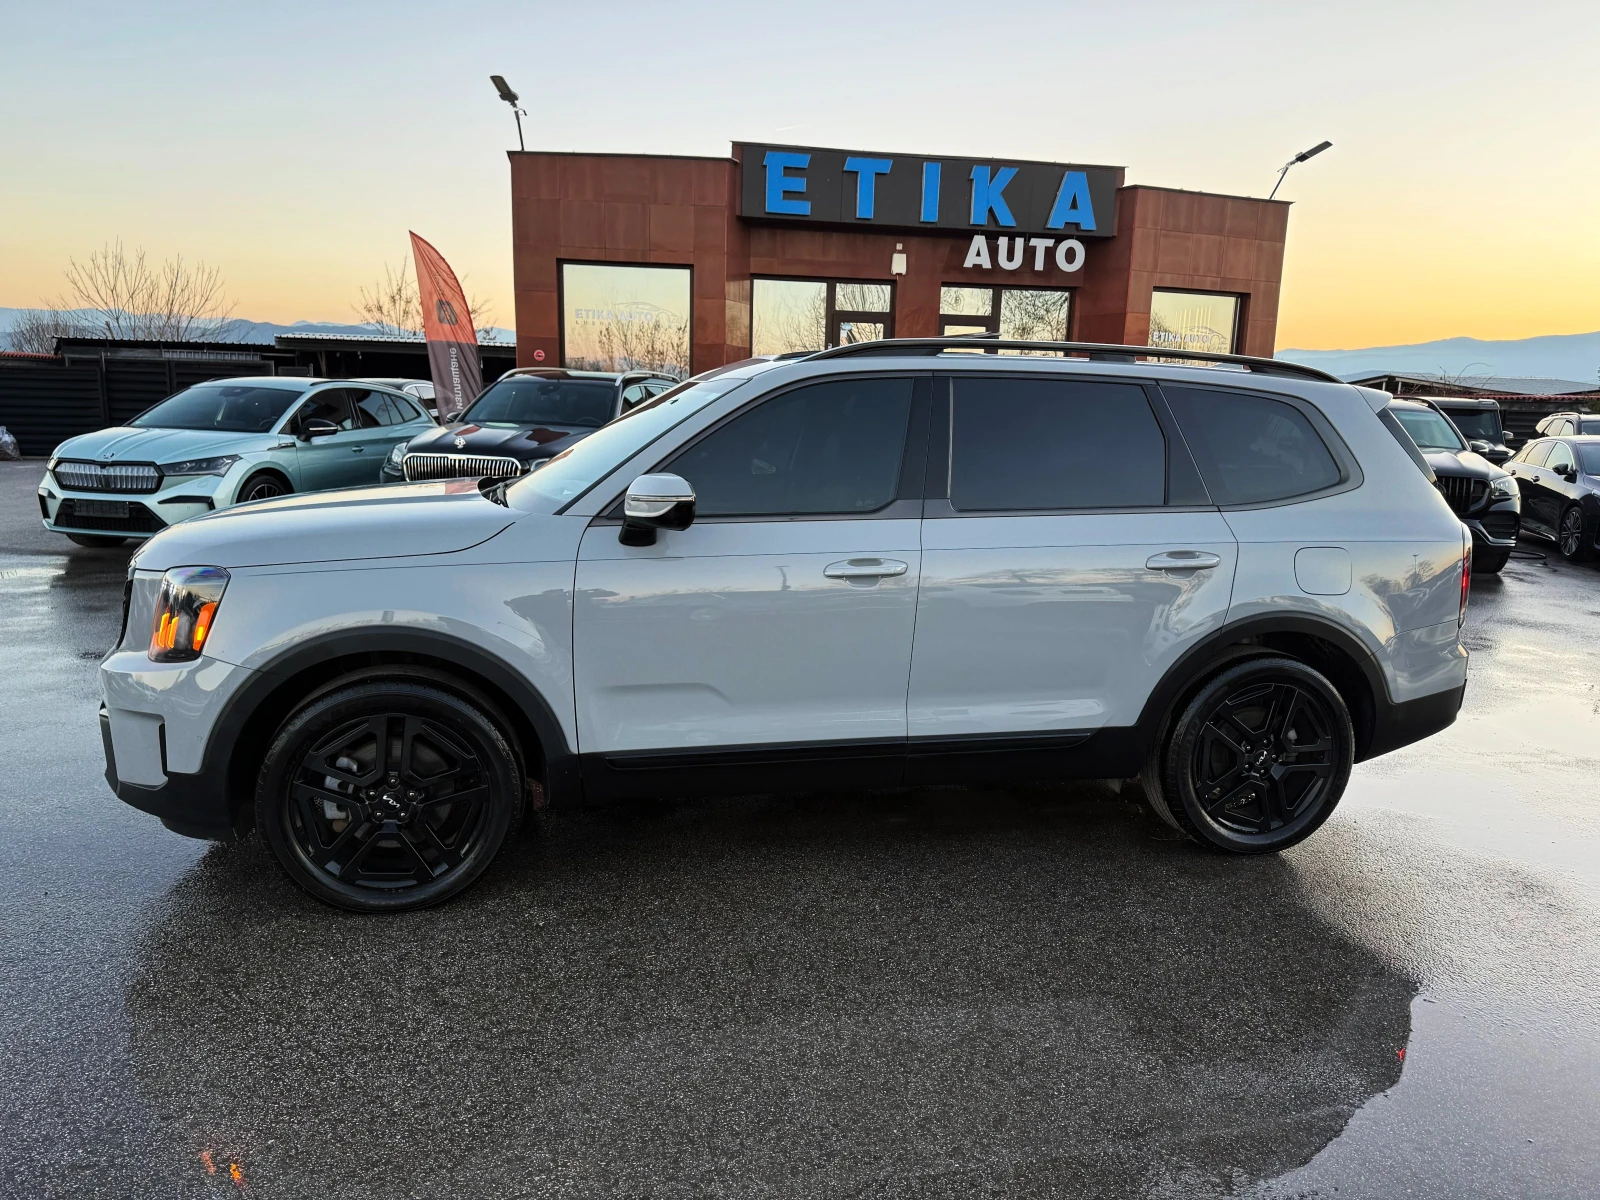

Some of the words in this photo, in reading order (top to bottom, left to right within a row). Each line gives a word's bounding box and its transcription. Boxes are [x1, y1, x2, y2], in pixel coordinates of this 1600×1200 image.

[763, 151, 1097, 231] ETIKA
[962, 234, 1086, 273] AUTO
[575, 309, 614, 320] ETIKA
[617, 311, 653, 321] AUTO
[1153, 331, 1182, 342] ETIKA
